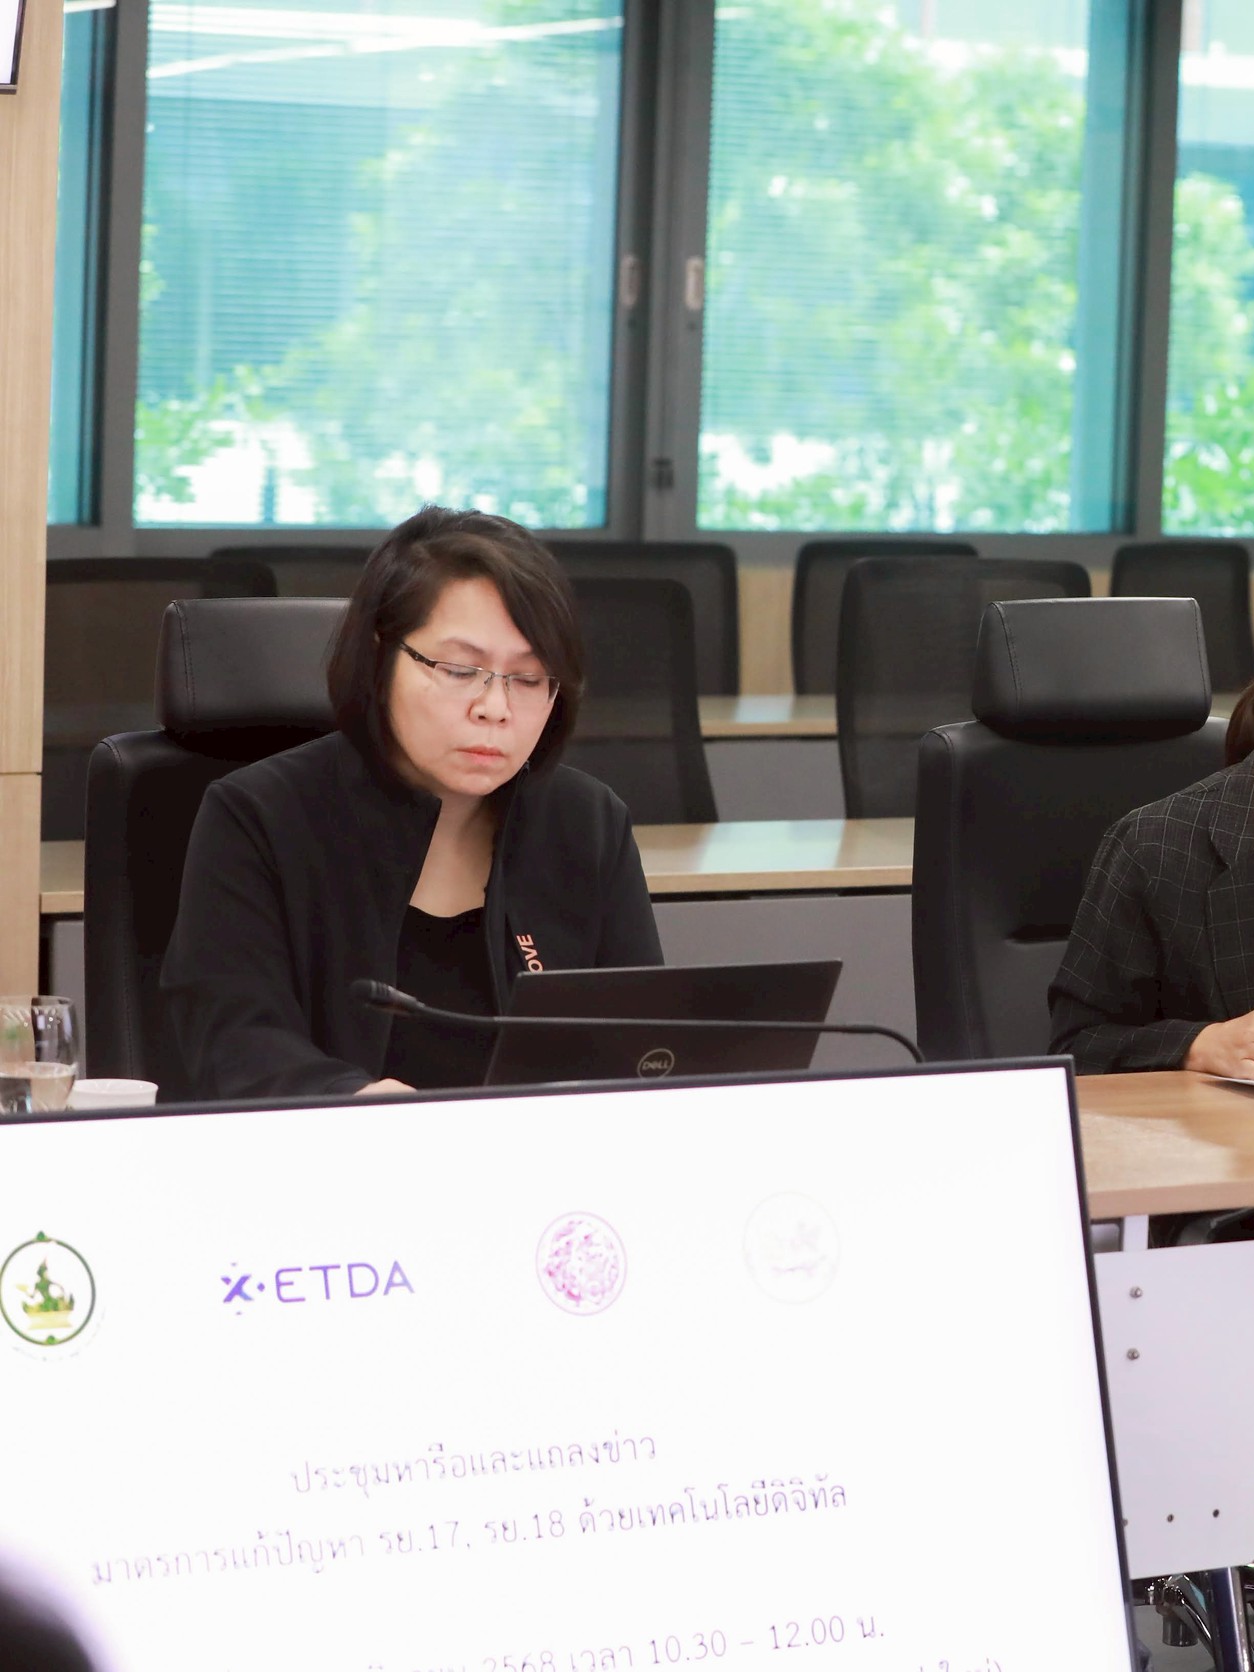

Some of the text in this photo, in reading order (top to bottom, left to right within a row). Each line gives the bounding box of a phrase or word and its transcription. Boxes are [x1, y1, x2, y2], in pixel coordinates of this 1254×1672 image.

[274, 1260, 416, 1304] ETDA
[290, 1428, 656, 1499] ประชุมหารือและแถลงข่าว
[92, 1529, 365, 1587] มาตรการแก้ปัญหา
[483, 1508, 566, 1544] รย.18
[578, 1473, 847, 1536] ด้วยเทคโนโลยีดิจิทัล
[648, 1629, 727, 1665] 10.30
[769, 1615, 845, 1651] 12.00
[857, 1615, 885, 1639] น.
